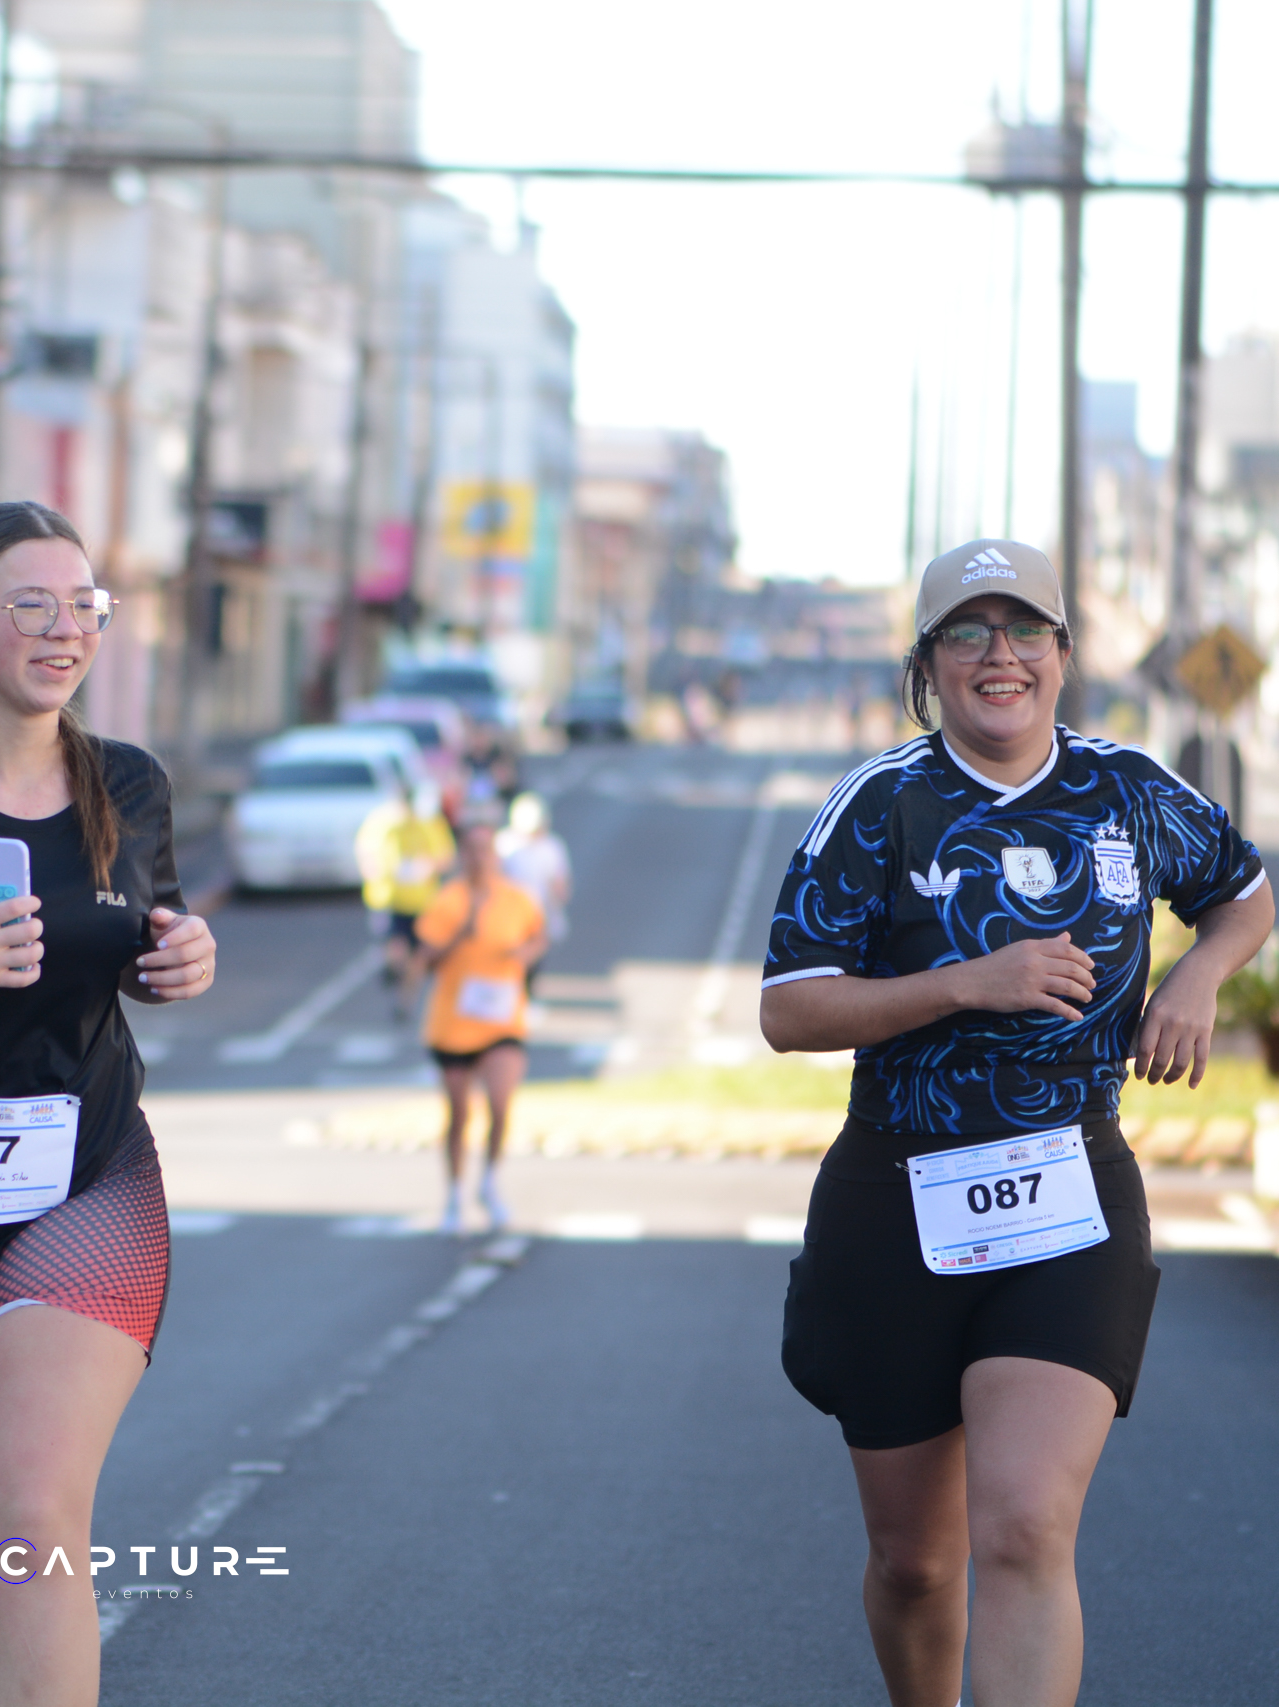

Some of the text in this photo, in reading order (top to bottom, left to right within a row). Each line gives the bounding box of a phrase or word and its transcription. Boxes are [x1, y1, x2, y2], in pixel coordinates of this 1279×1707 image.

[961, 566, 1017, 584] adidas
[96, 891, 127, 907] FILA
[29, 1115, 53, 1123] CAUSA
[1045, 1149, 1066, 1158] CAUSA
[11, 1172, 28, 1181] Silva
[967, 1172, 1042, 1214] 087
[985, 1223, 1002, 1231] NOEMI
[1003, 1219, 1023, 1228] BARRIO
